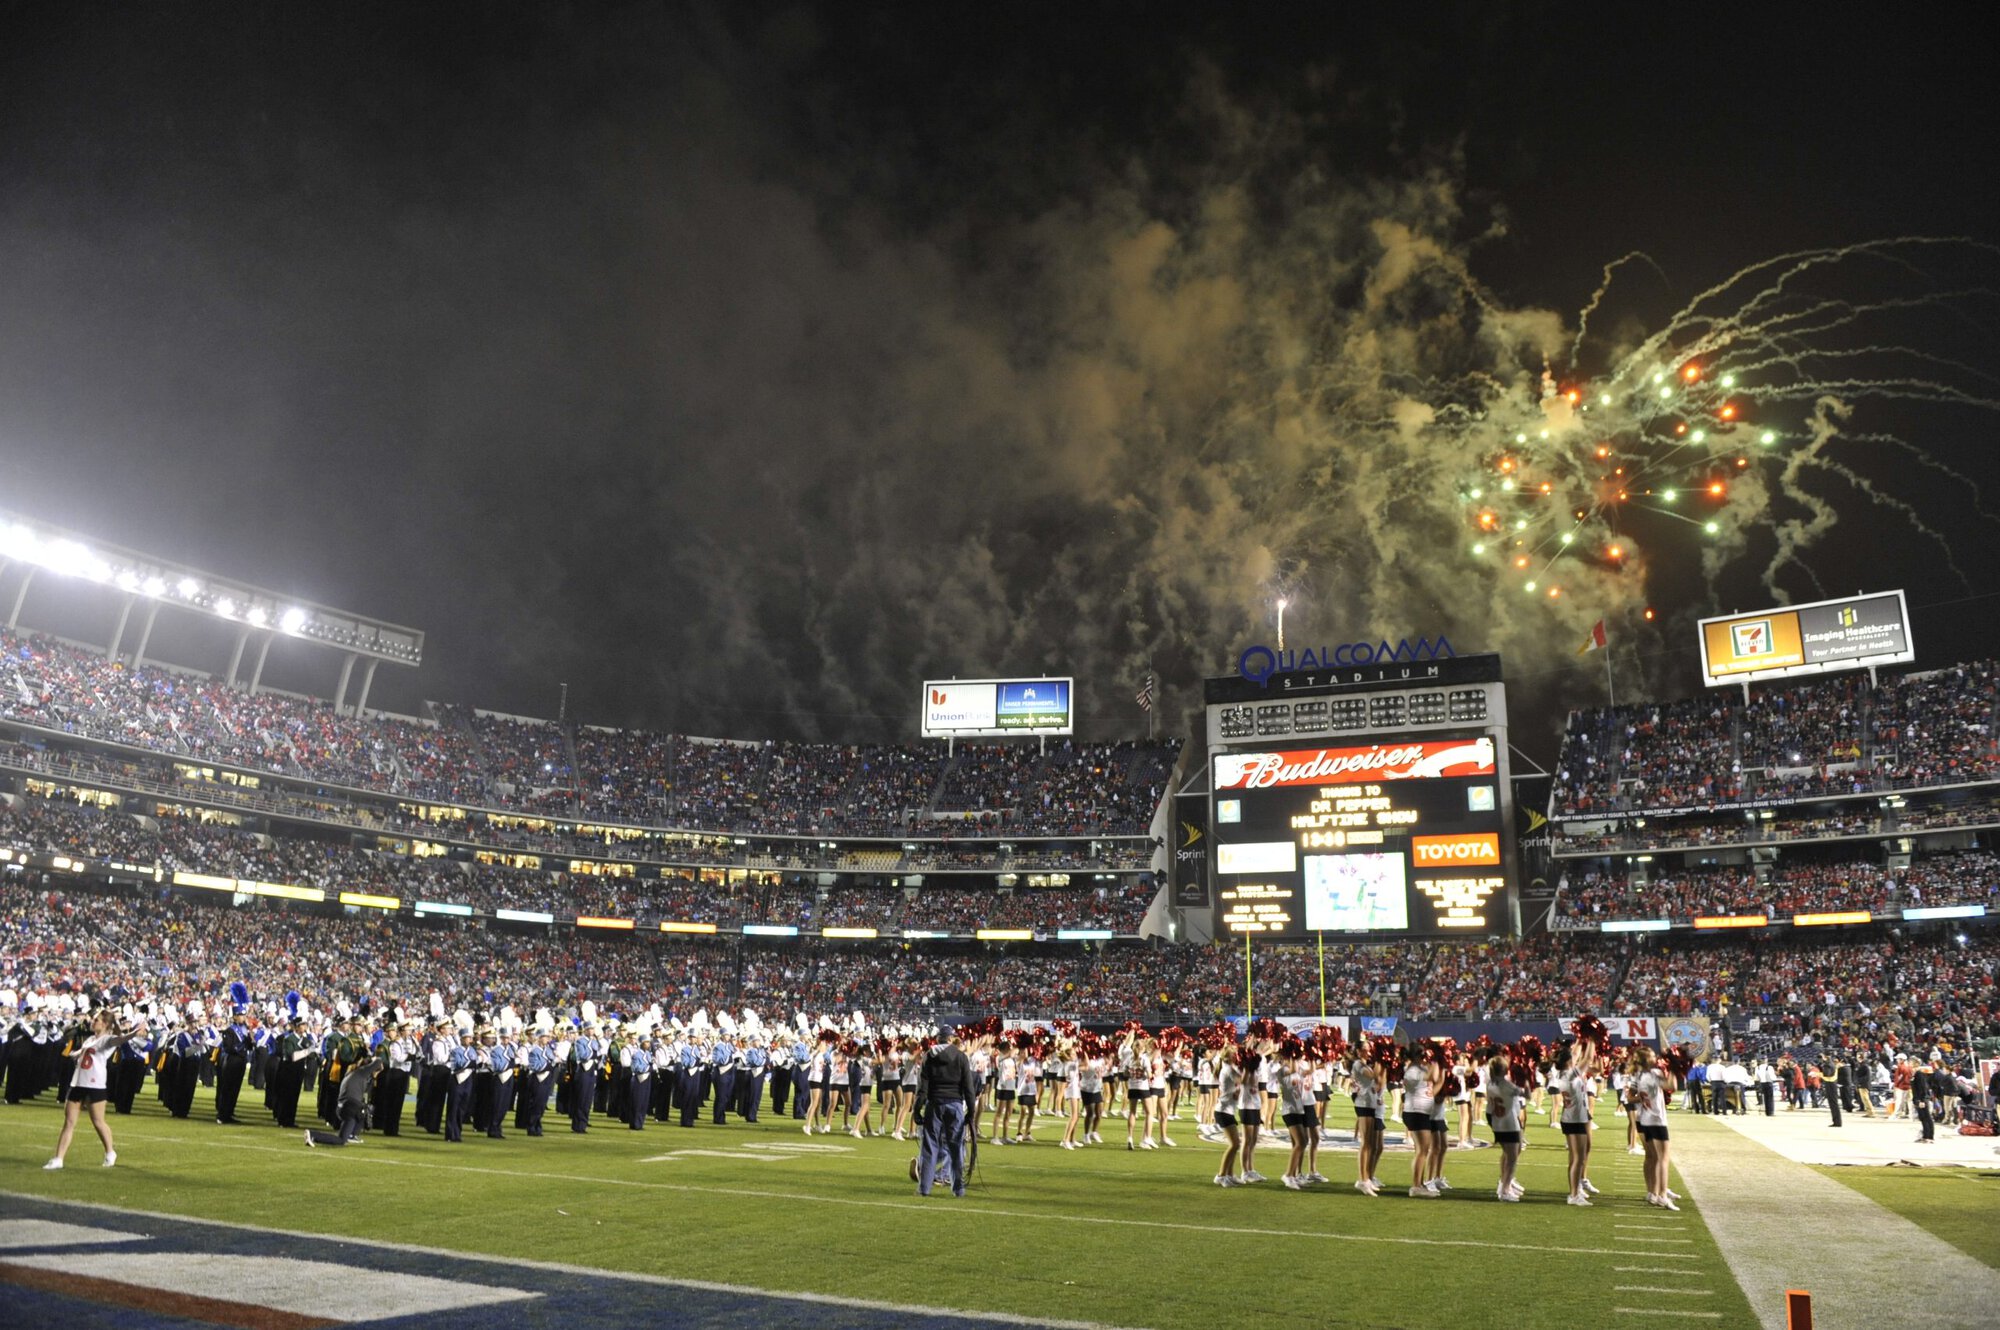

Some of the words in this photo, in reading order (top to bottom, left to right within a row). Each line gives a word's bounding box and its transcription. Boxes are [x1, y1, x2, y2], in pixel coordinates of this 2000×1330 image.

[1741, 628, 1762, 653] 7
[1804, 630, 1844, 642] Imaging
[1845, 623, 1900, 637] Healthcare
[1812, 649, 1828, 657] Your
[1830, 645, 1857, 654] Partner
[1869, 640, 1894, 650] Health
[1240, 635, 1456, 688] QUALCOMM
[1284, 666, 1439, 688] STADIUM
[1038, 716, 1063, 724] thrive.
[1241, 745, 1424, 788] Budweiser
[1364, 785, 1381, 796] TO
[1311, 800, 1331, 813] DR
[1336, 797, 1391, 812] PEPPER
[1291, 813, 1368, 828] HALFTIME
[1376, 810, 1417, 824] SHOW
[1177, 850, 1205, 861] Sprint
[1417, 843, 1495, 860] TOYOTA
[1627, 1020, 1649, 1037] N
